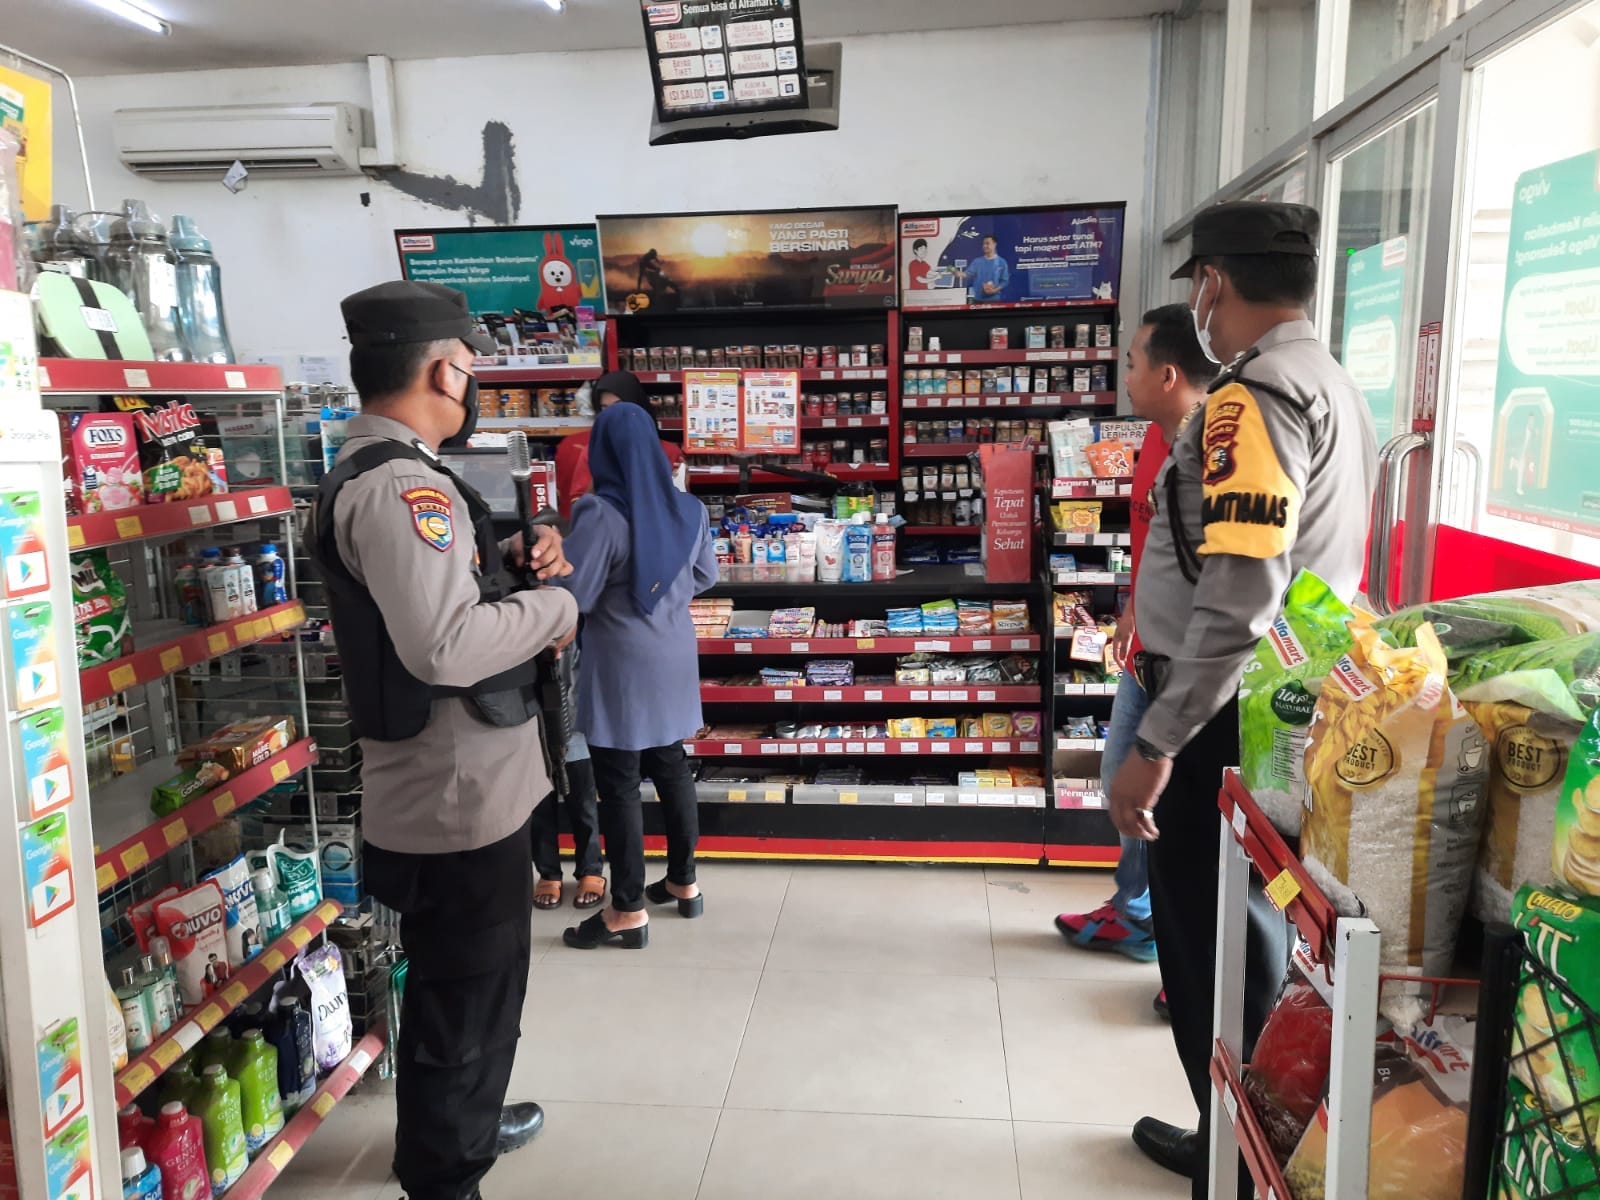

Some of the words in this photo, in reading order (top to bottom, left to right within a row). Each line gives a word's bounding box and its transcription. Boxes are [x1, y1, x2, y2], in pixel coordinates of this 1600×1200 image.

[682, 4, 709, 15] Semua
[711, 1, 728, 11] bisa
[729, 0, 737, 9] di
[569, 234, 593, 248] virgo
[769, 230, 807, 241] YANG
[809, 229, 849, 239] PASTI
[1023, 236, 1048, 244] Harus
[1049, 234, 1071, 242] setor
[1072, 232, 1095, 240] tunai
[769, 240, 849, 253] BERSINAR
[1014, 245, 1032, 254] tapi
[1033, 244, 1060, 253] mager
[1062, 241, 1078, 250] cari
[1079, 241, 1103, 249] ATM?
[825, 264, 892, 293] Surya
[1114, 423, 1144, 431] PULSA
[1055, 479, 1089, 487] Permen
[993, 496, 1025, 512] Tepat
[993, 537, 1025, 551] Sehat
[1274, 701, 1311, 714] NATURAL
[24, 736, 50, 750] Google
[253, 749, 271, 766] GOLD
[1507, 741, 1545, 764] BEST
[1507, 757, 1542, 772] PRODUCT
[1060, 789, 1095, 798] Permen
[26, 842, 51, 860] Google
